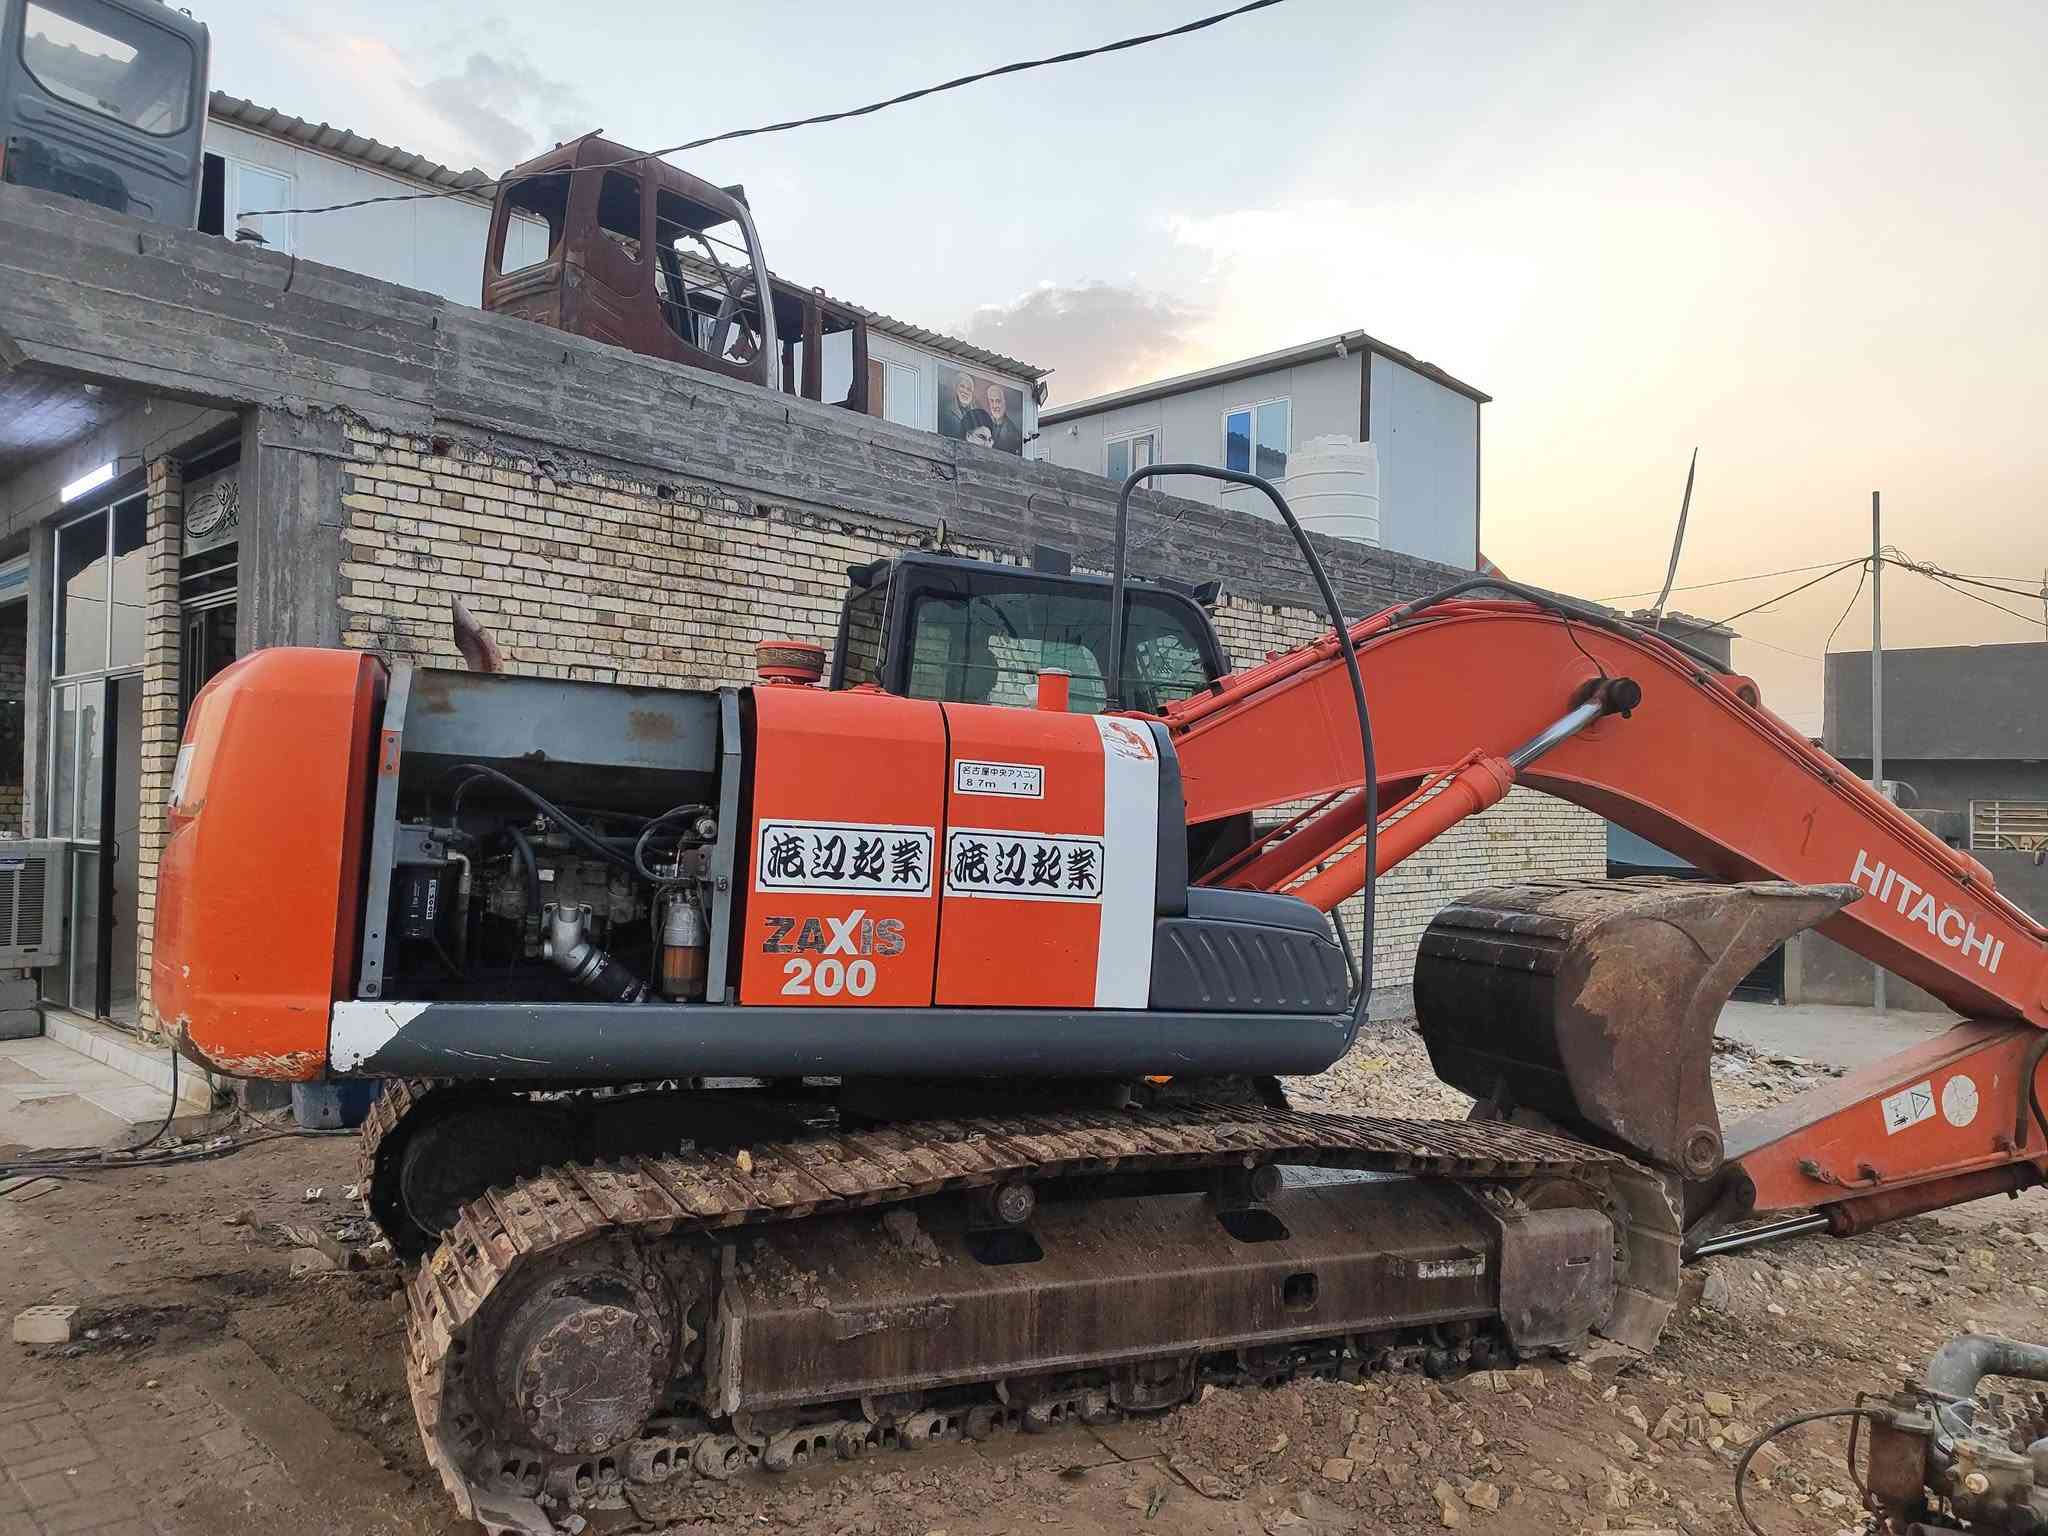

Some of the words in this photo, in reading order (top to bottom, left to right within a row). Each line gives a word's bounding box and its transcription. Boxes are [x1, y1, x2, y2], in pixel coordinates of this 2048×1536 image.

[763, 910, 906, 956] ZAXIS
[1850, 849, 2005, 974] HITACHI
[781, 959, 876, 997] 200
